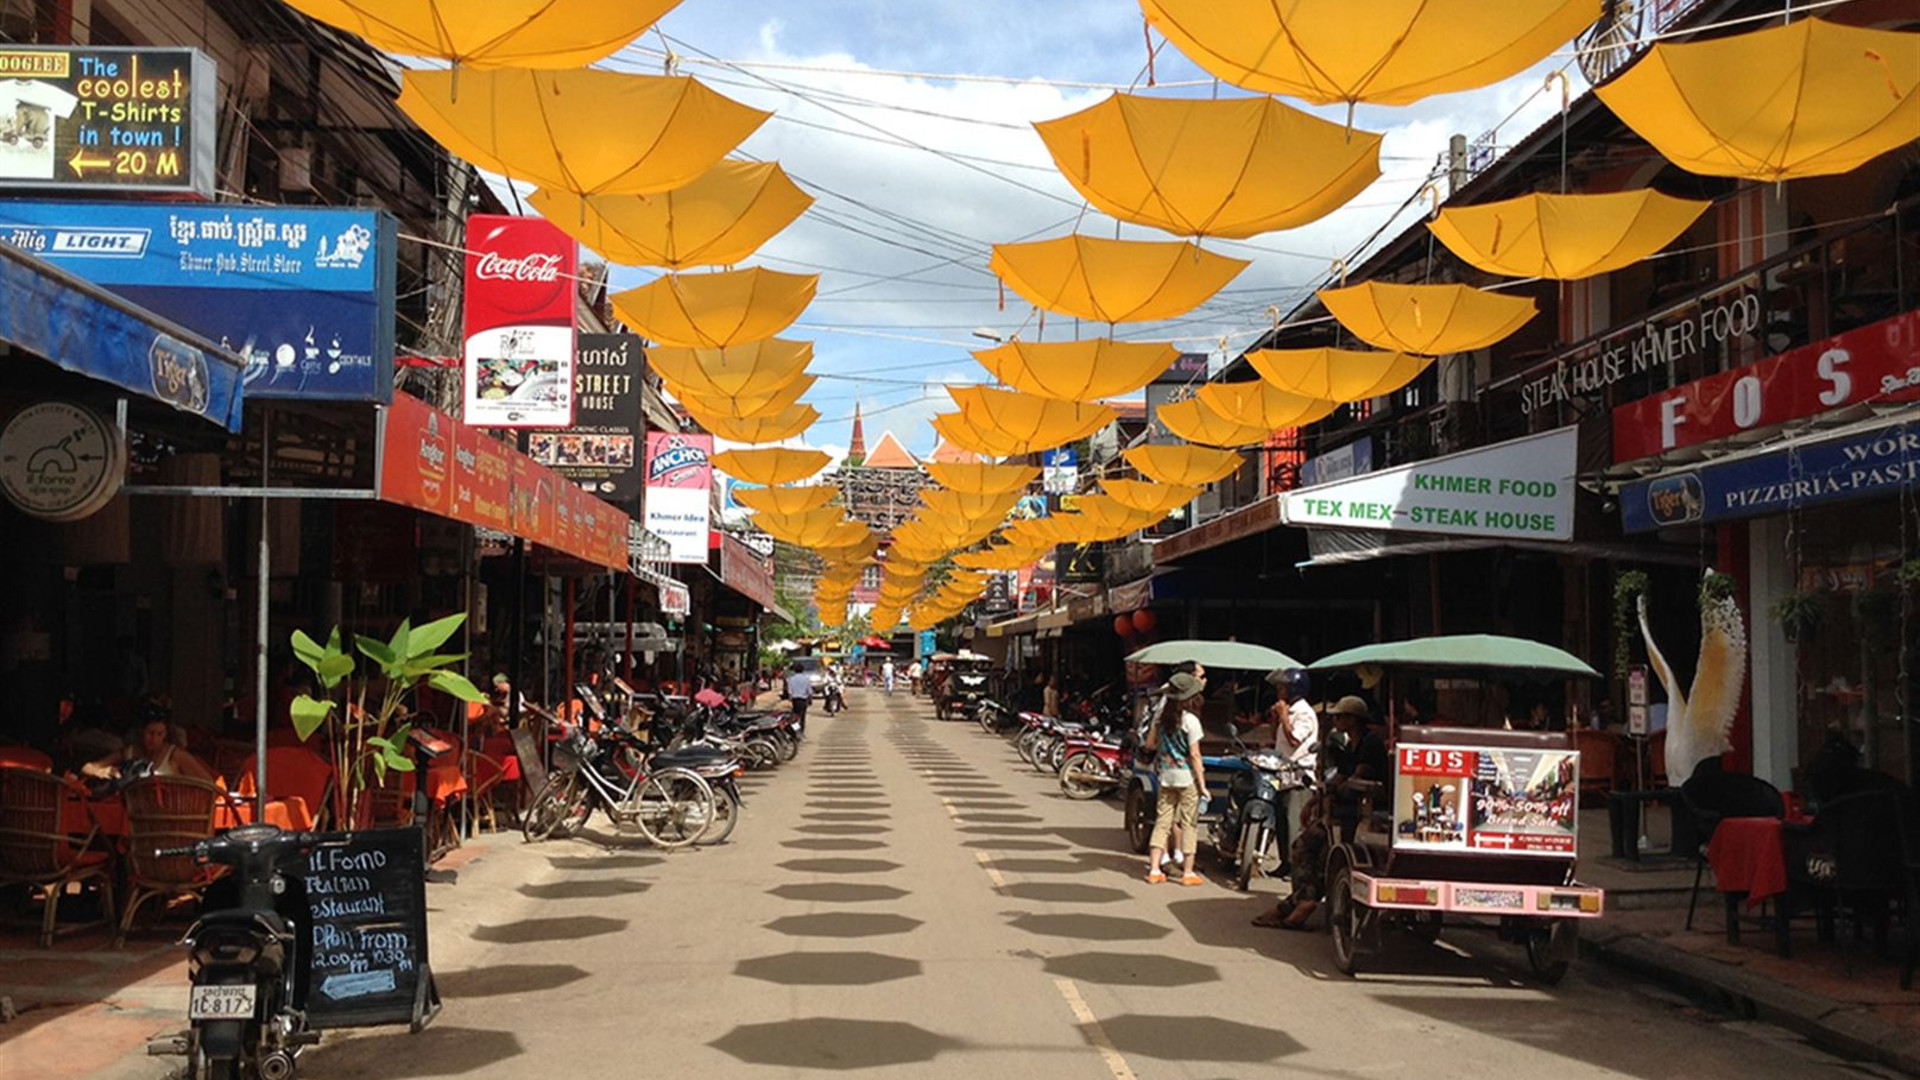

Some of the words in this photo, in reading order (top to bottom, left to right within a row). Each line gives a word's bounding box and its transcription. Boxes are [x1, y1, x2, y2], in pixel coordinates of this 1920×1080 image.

[77, 54, 182, 99] coolest
[79, 57, 118, 77] The
[81, 101, 181, 122] T-Shirts
[79, 125, 98, 145] in
[110, 126, 163, 146] town
[116, 152, 147, 174] 20
[156, 153, 179, 176] M
[66, 235, 131, 249] LIGHT
[476, 251, 563, 282] Coca-Cola
[1521, 364, 1570, 415] STEAK
[1572, 346, 1626, 396] HOUSE
[1631, 319, 1696, 374] KHMER
[1700, 293, 1760, 348] FOOD
[575, 374, 631, 395] STREET
[1414, 473, 1492, 495] KHMER
[1499, 479, 1557, 498] FOOD
[1303, 499, 1342, 517] TEX
[1484, 512, 1556, 532] HOUSE
[1406, 749, 1464, 769] FOS
